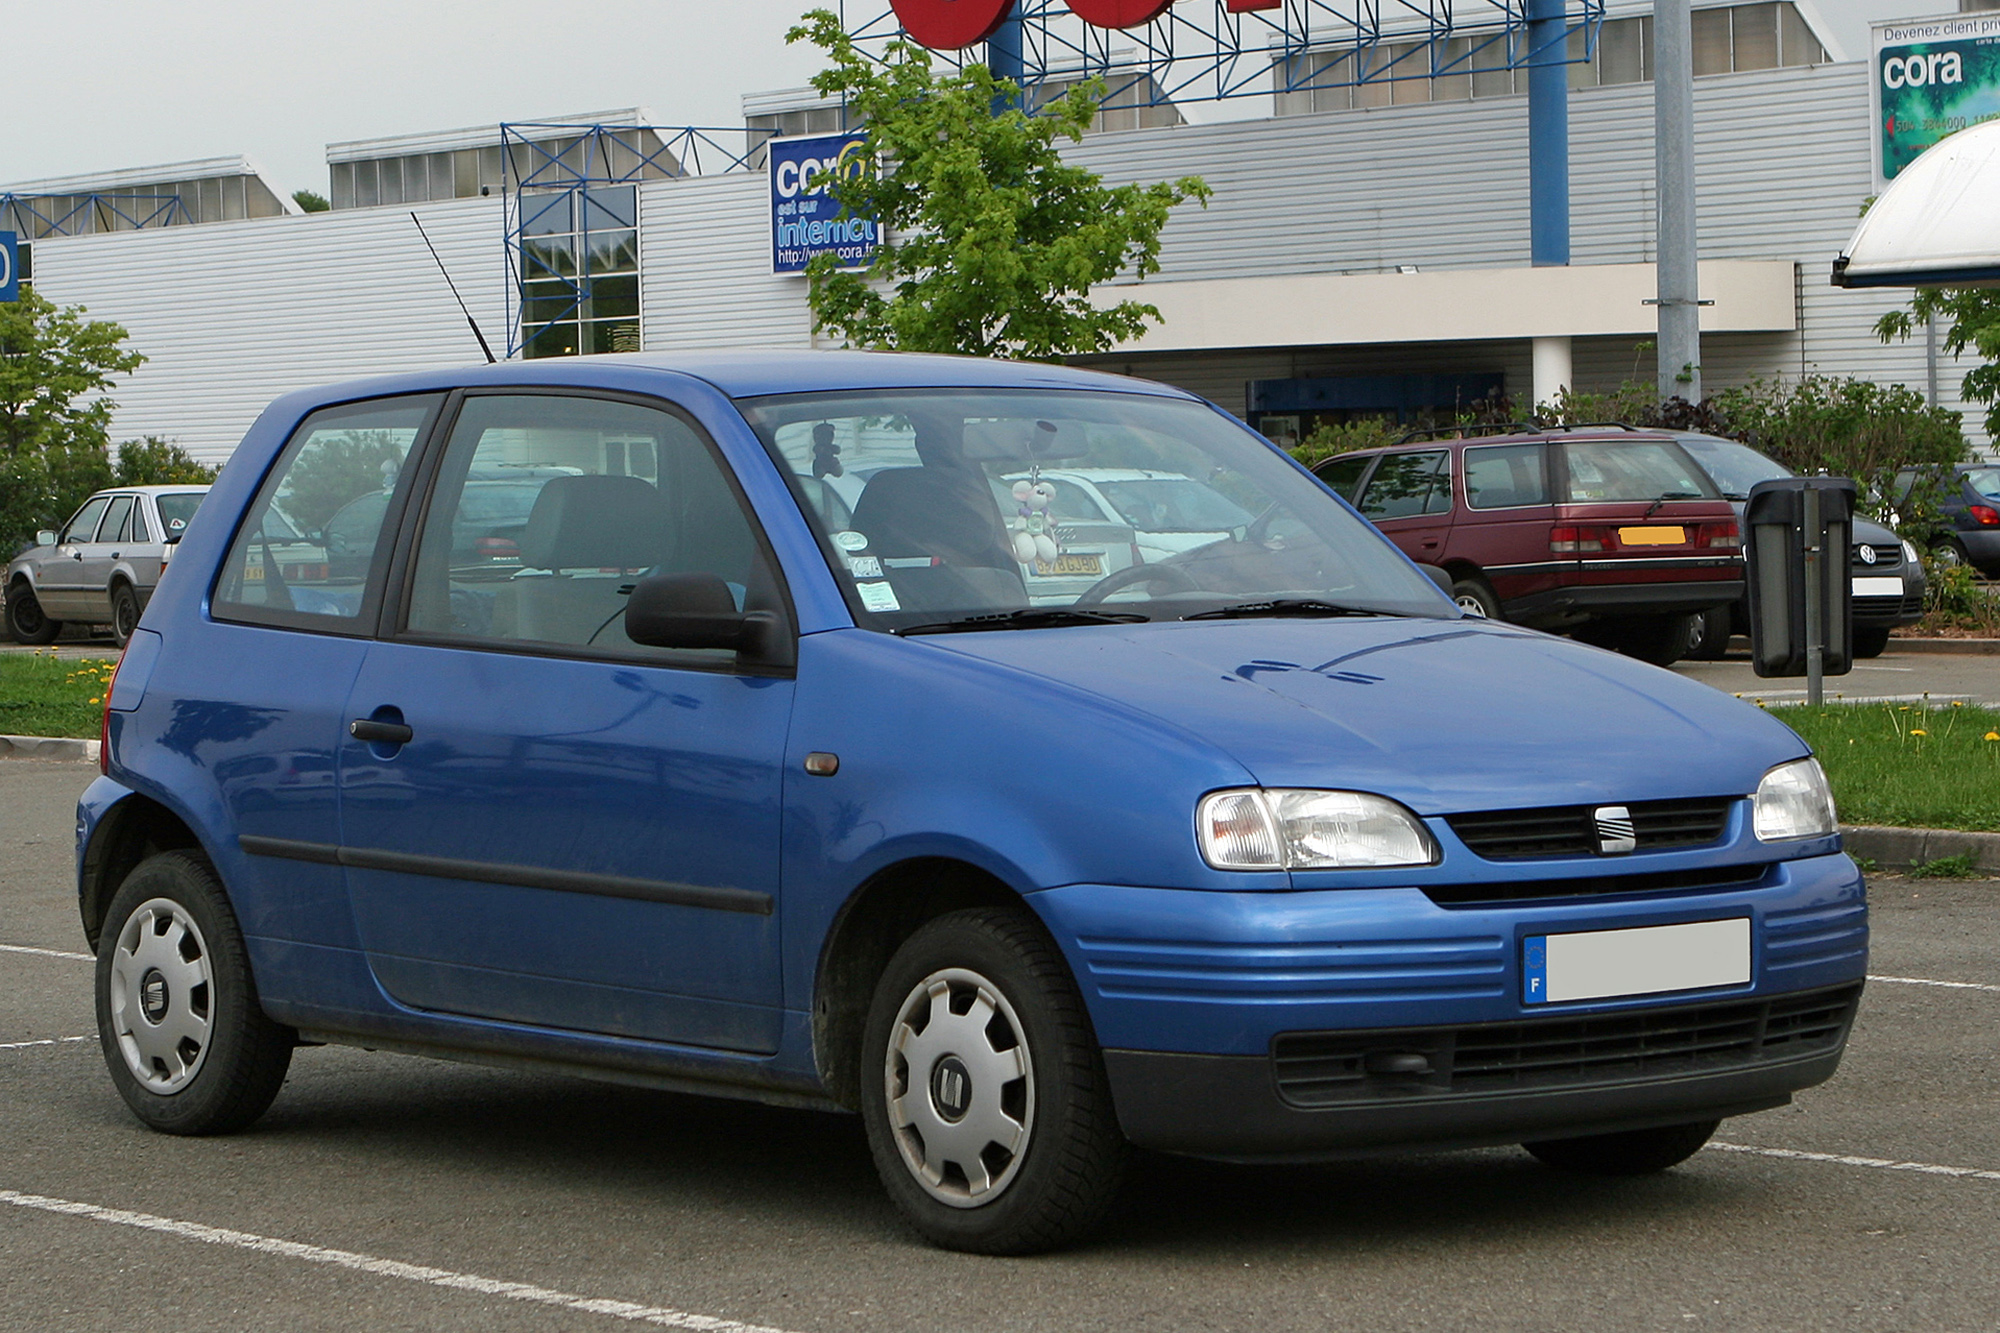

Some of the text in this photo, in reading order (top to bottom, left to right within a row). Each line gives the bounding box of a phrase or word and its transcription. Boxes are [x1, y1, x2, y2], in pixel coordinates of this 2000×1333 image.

[1884, 25, 1940, 41] Devenez
[1943, 21, 1978, 35] client
[1884, 51, 1963, 90] cora
[777, 200, 818, 216] est sur
[777, 216, 875, 248] internet
[778, 242, 874, 266] http://wcora.fr
[1531, 977, 1540, 993] F
